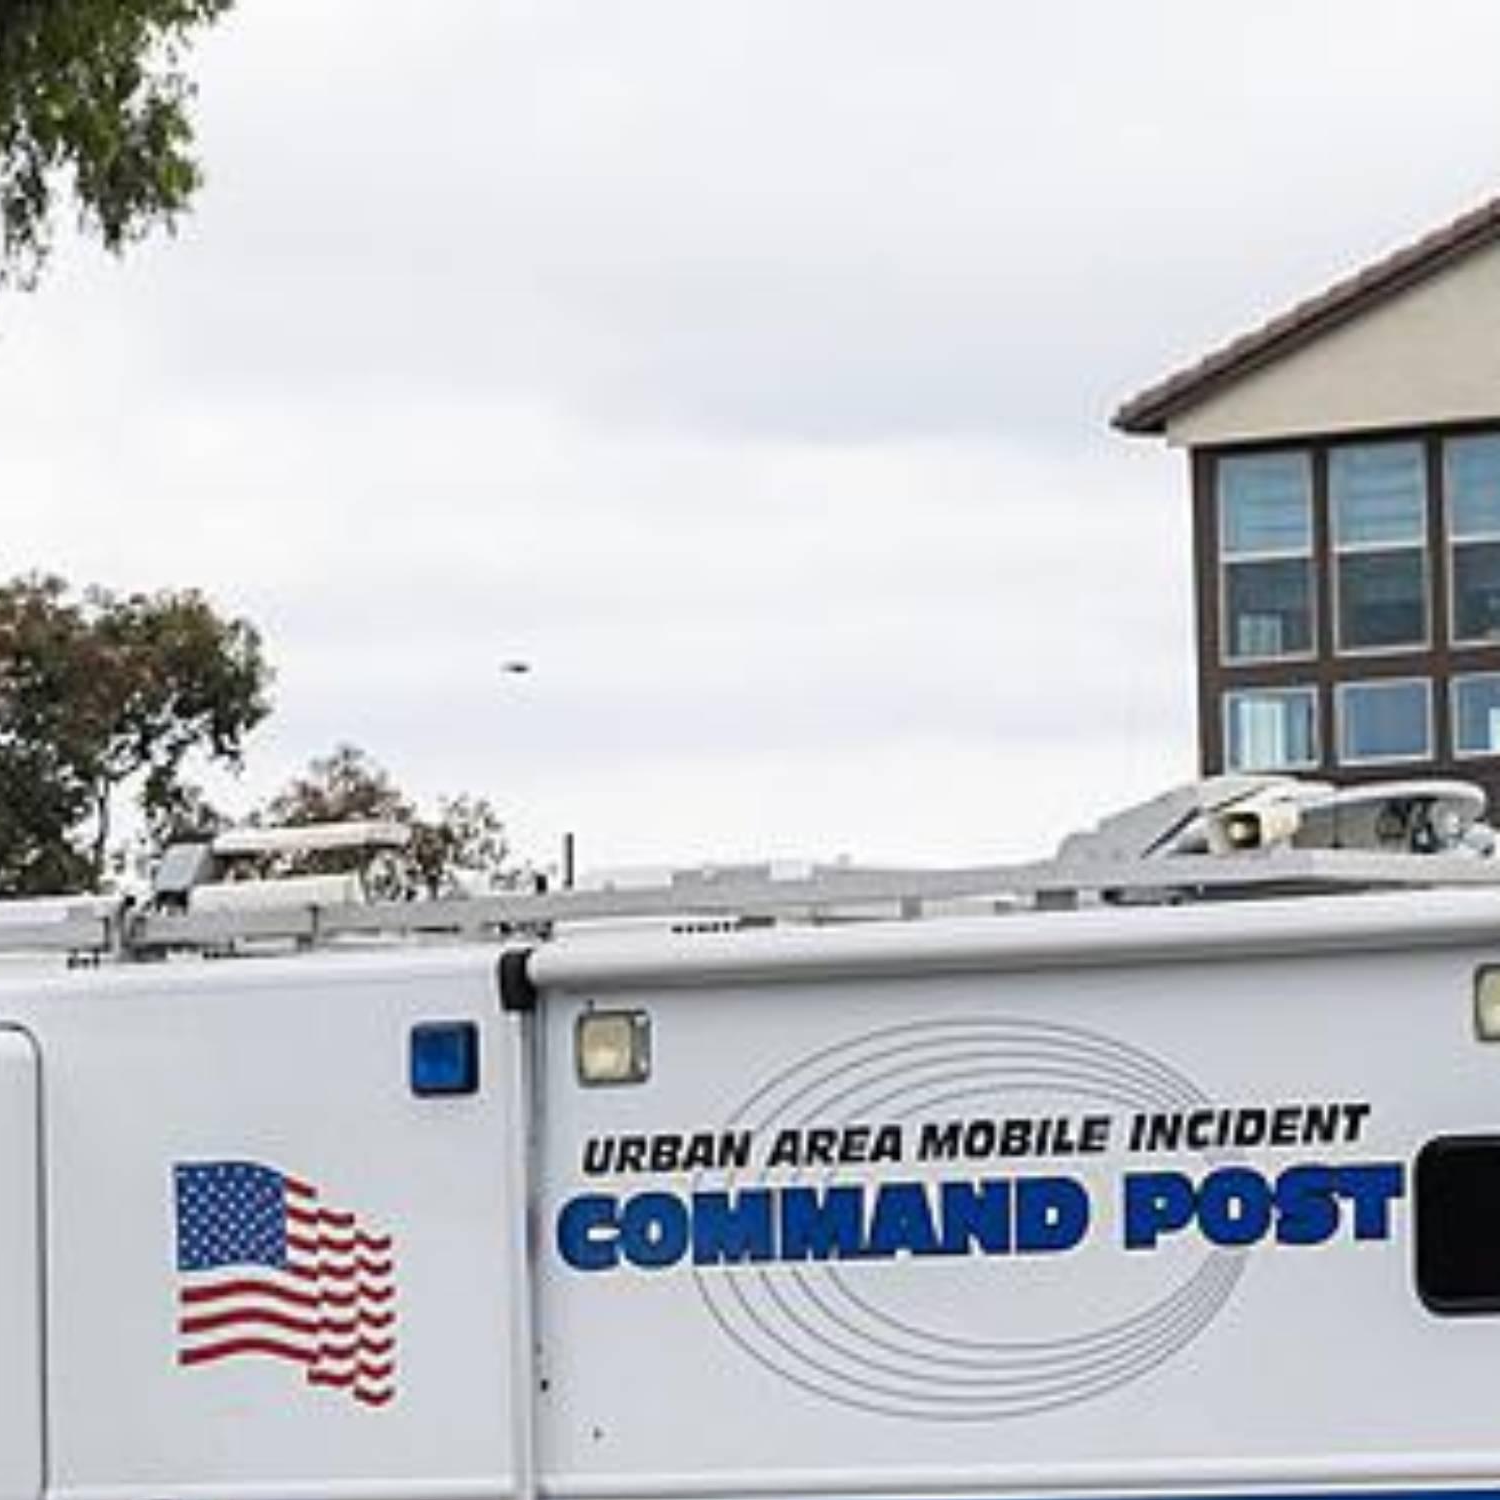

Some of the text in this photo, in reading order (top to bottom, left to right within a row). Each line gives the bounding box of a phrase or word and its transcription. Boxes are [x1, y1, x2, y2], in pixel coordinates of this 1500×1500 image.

[582, 1103, 1371, 1174] URBAN AREA MOBILE INCIDENT
[557, 1161, 1403, 1271] COMMAND POST
